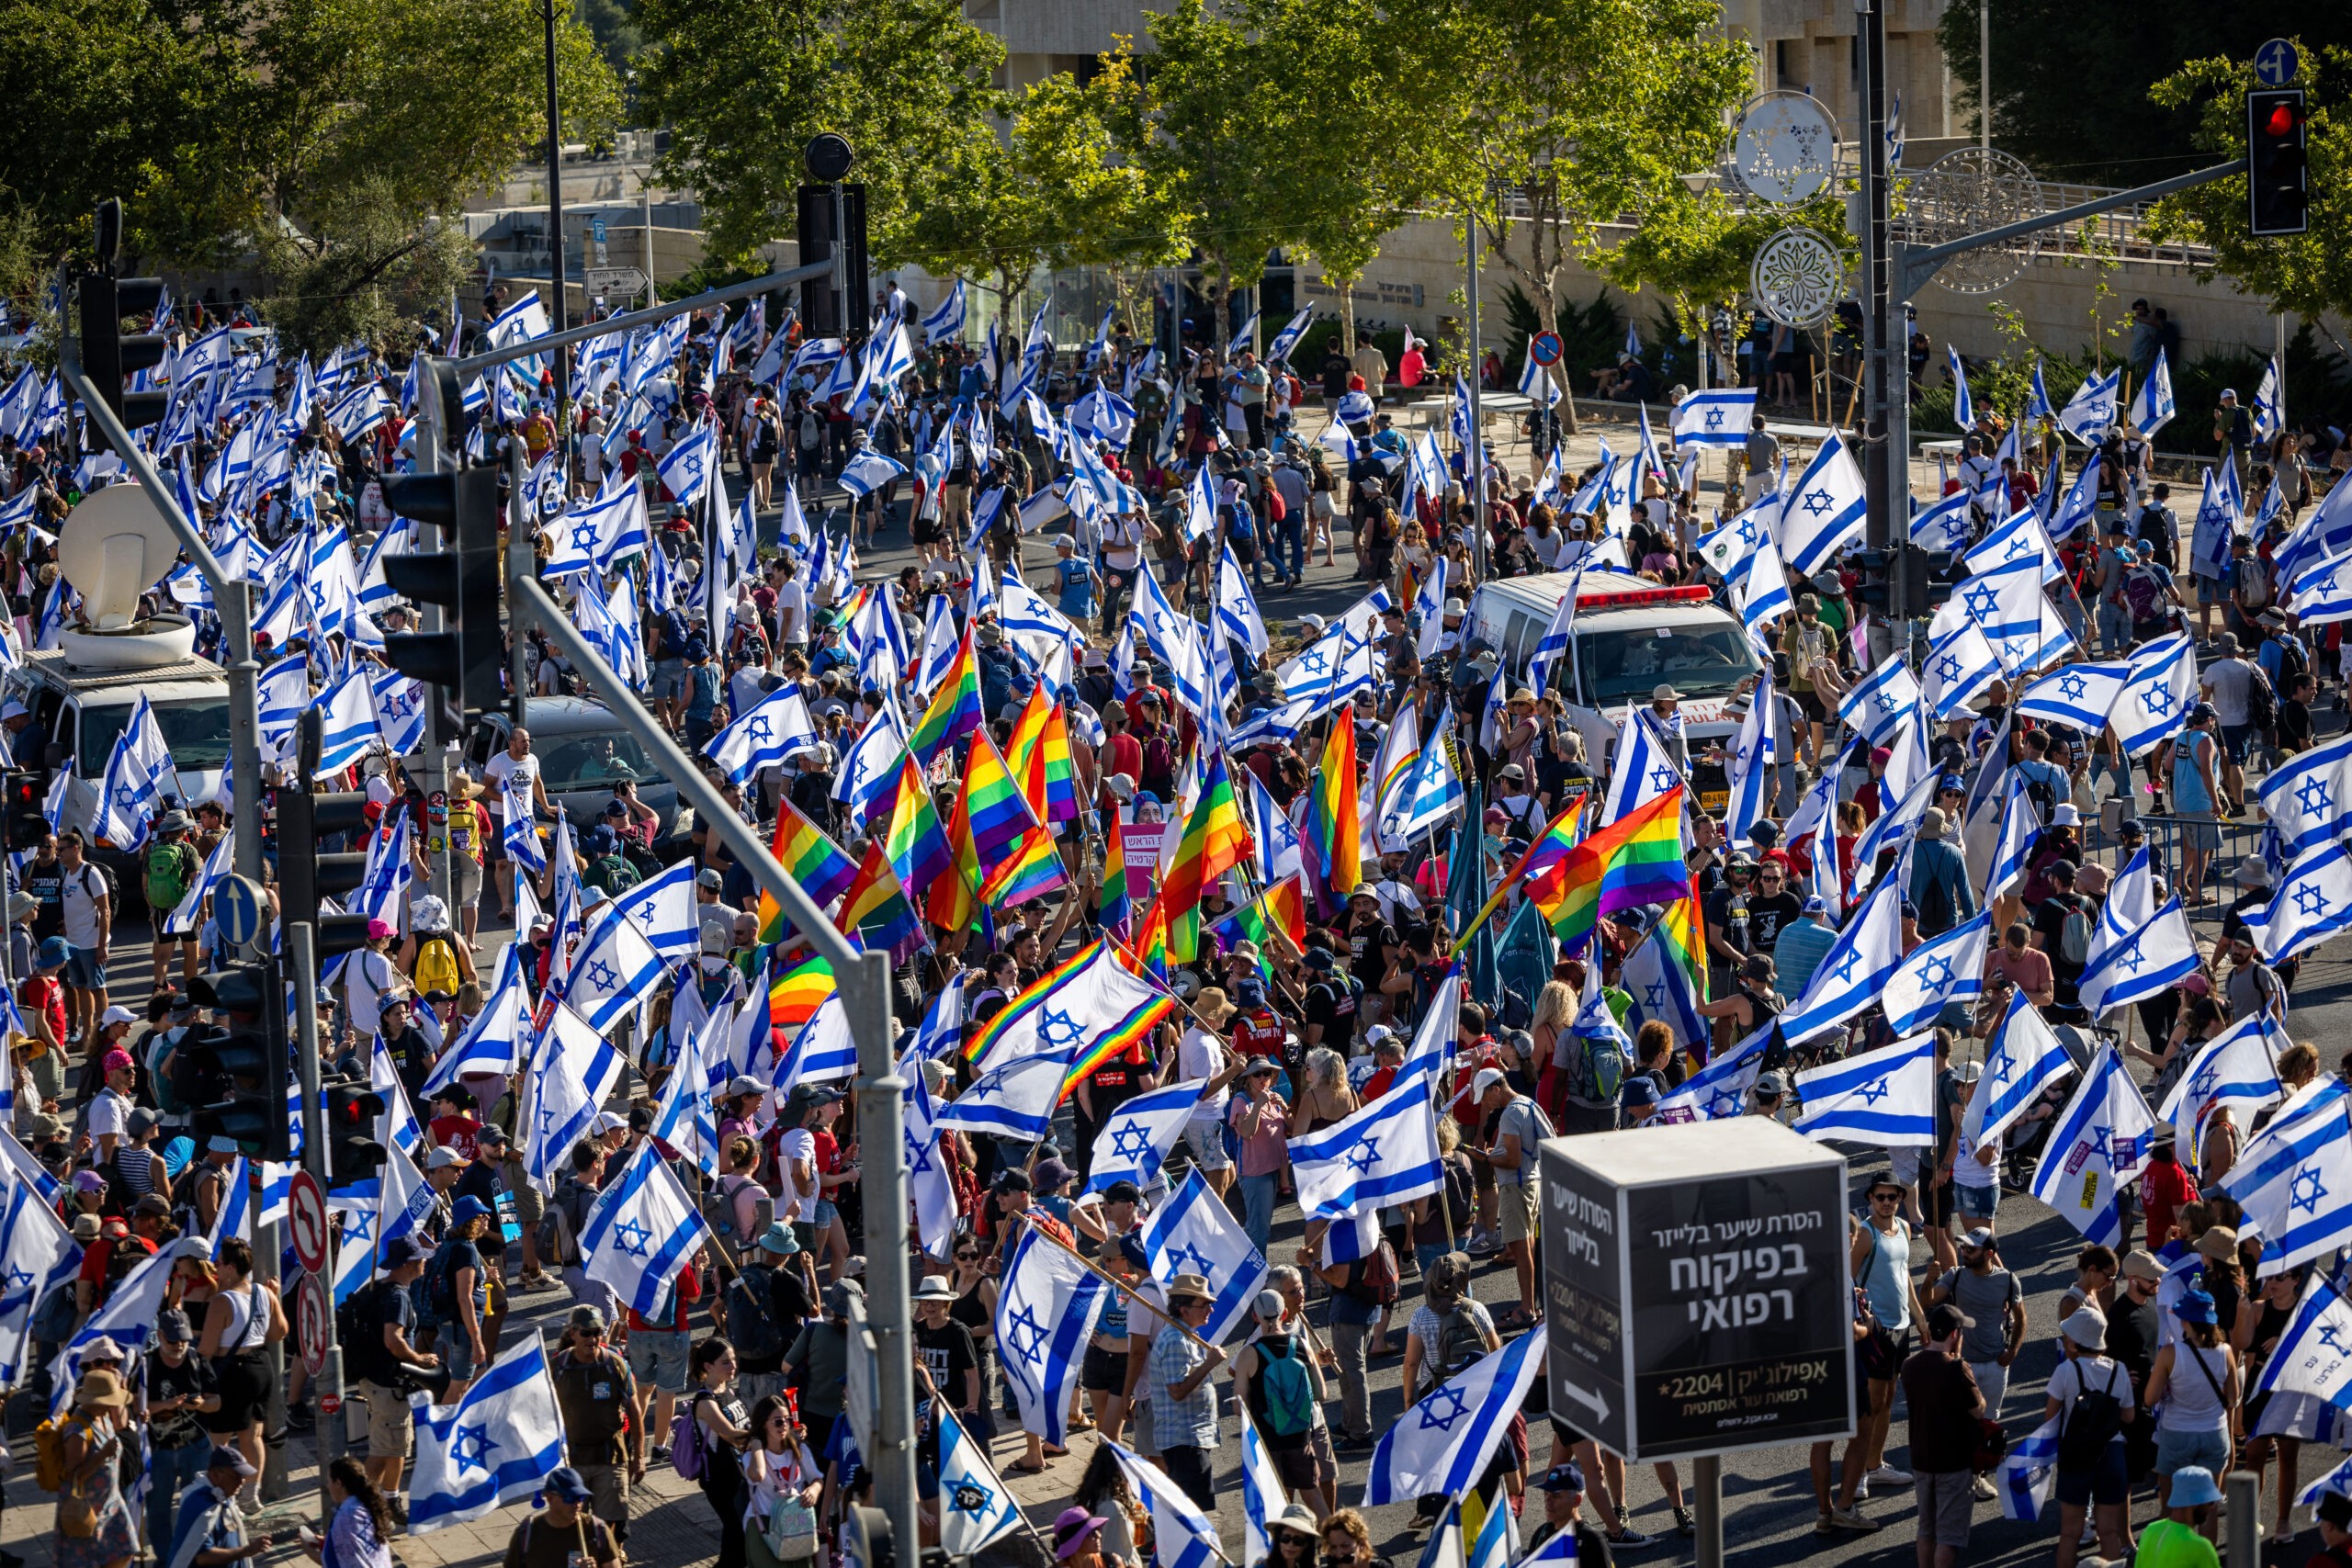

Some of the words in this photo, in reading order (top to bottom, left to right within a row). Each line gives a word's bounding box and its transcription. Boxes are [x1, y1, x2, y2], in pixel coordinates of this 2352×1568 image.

[593, 272, 610, 280] החוץ
[1128, 837, 1154, 846] הראש
[1127, 854, 1154, 866] קרטיה
[1578, 1195, 1612, 1235] הסרת
[1766, 1211, 1823, 1235] הסרת
[1652, 1224, 1711, 1248] בלייזר
[1713, 1218, 1762, 1240] שיער
[1564, 1226, 1600, 1267] בלייזר
[1669, 1243, 1808, 1296] בפיקוח
[1688, 1289, 1794, 1332] רפואי
[2304, 1356, 2318, 1369] עם
[2313, 1359, 2342, 1385] בארצנו
[1682, 1398, 1737, 1416] אסתטית
[1766, 1388, 1808, 1404] רפואת
